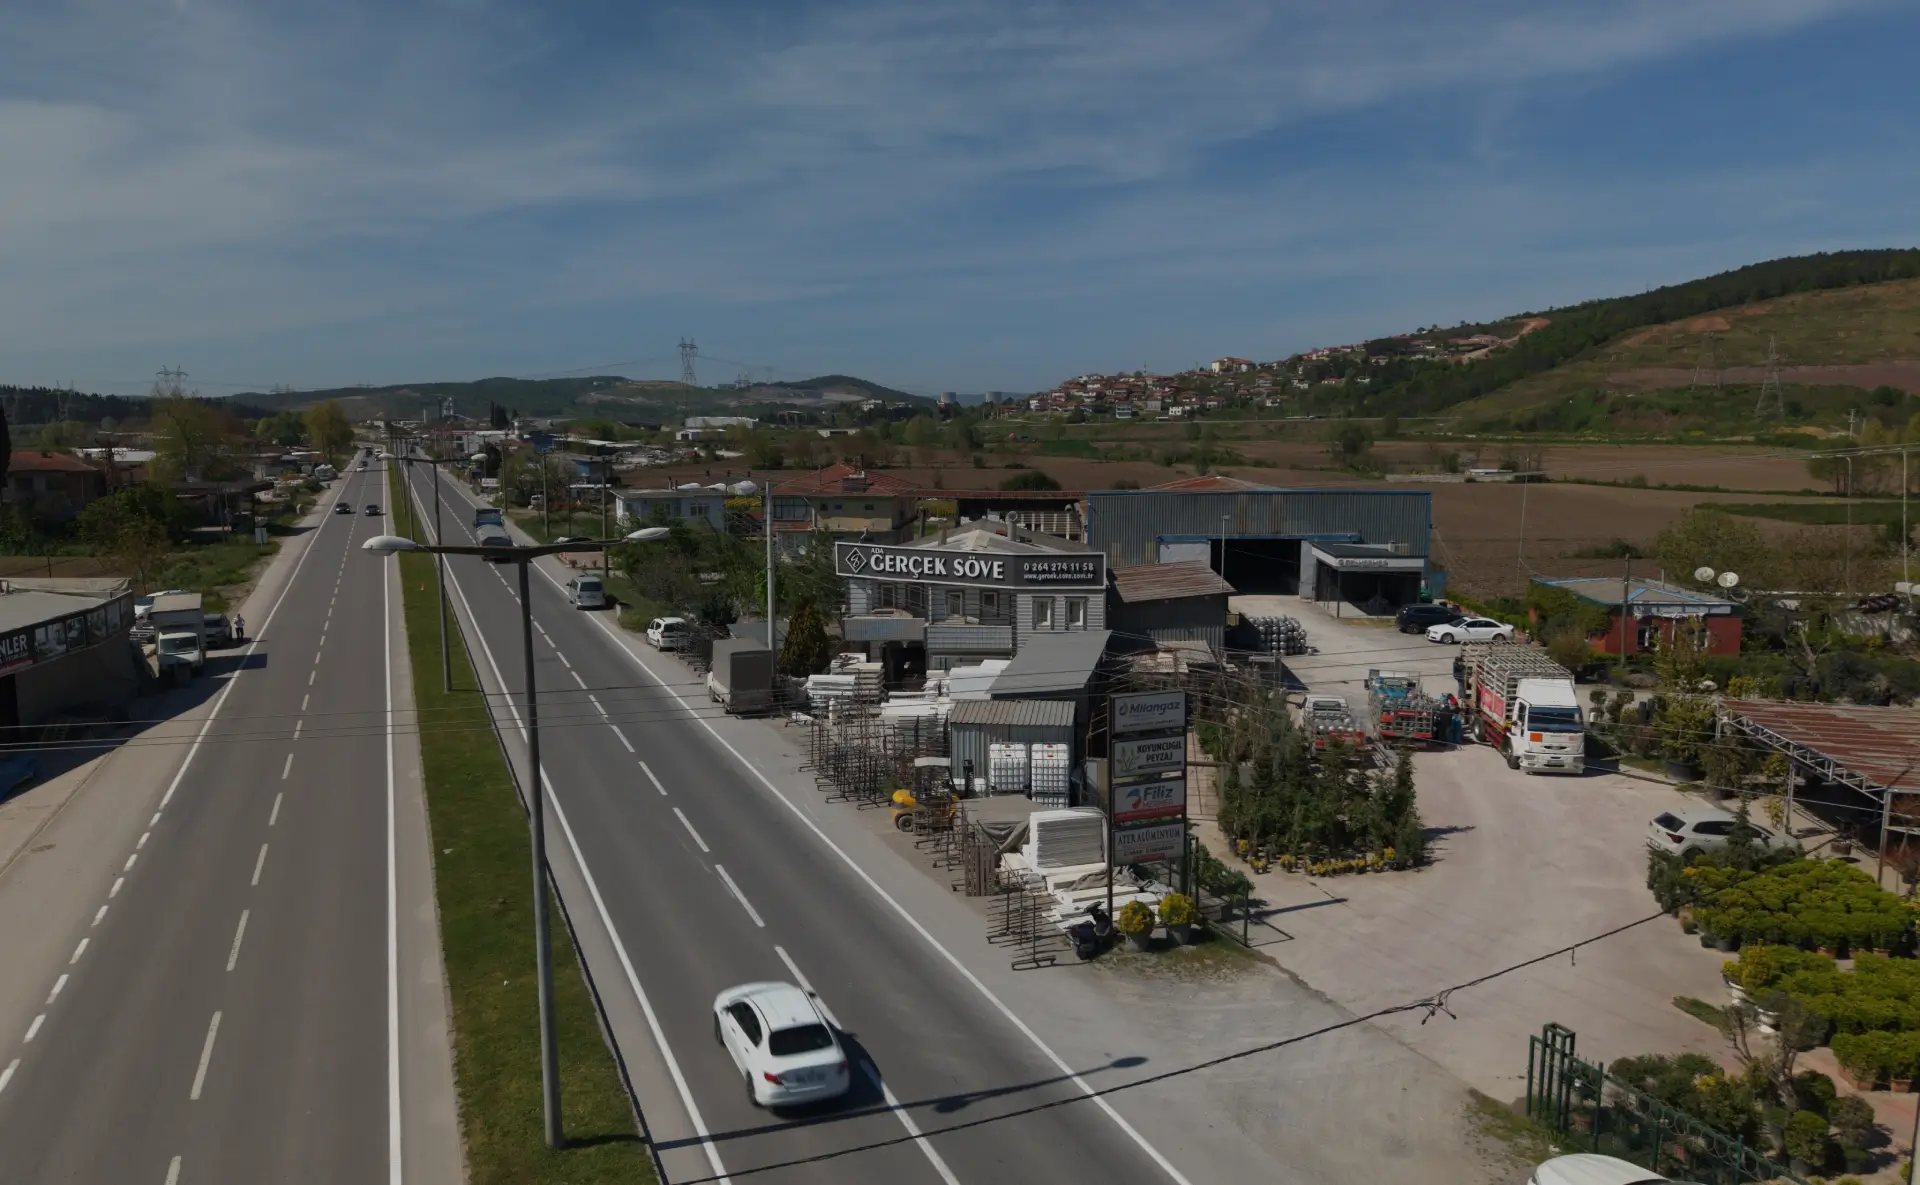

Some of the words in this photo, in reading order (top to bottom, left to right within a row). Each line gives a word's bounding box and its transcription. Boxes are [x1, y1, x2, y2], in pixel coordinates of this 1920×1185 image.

[870, 554, 947, 578] GERÇEK
[953, 556, 1004, 579] SÖVE
[1024, 562, 1030, 571] 0
[1032, 562, 1049, 571] 264
[1051, 562, 1068, 571] 274
[1071, 562, 1079, 571] 11
[1083, 562, 1094, 571] 58
[1129, 701, 1181, 715] Milangaz
[1146, 752, 1173, 763] PEYZAJ
[1143, 784, 1174, 801] Filiz
